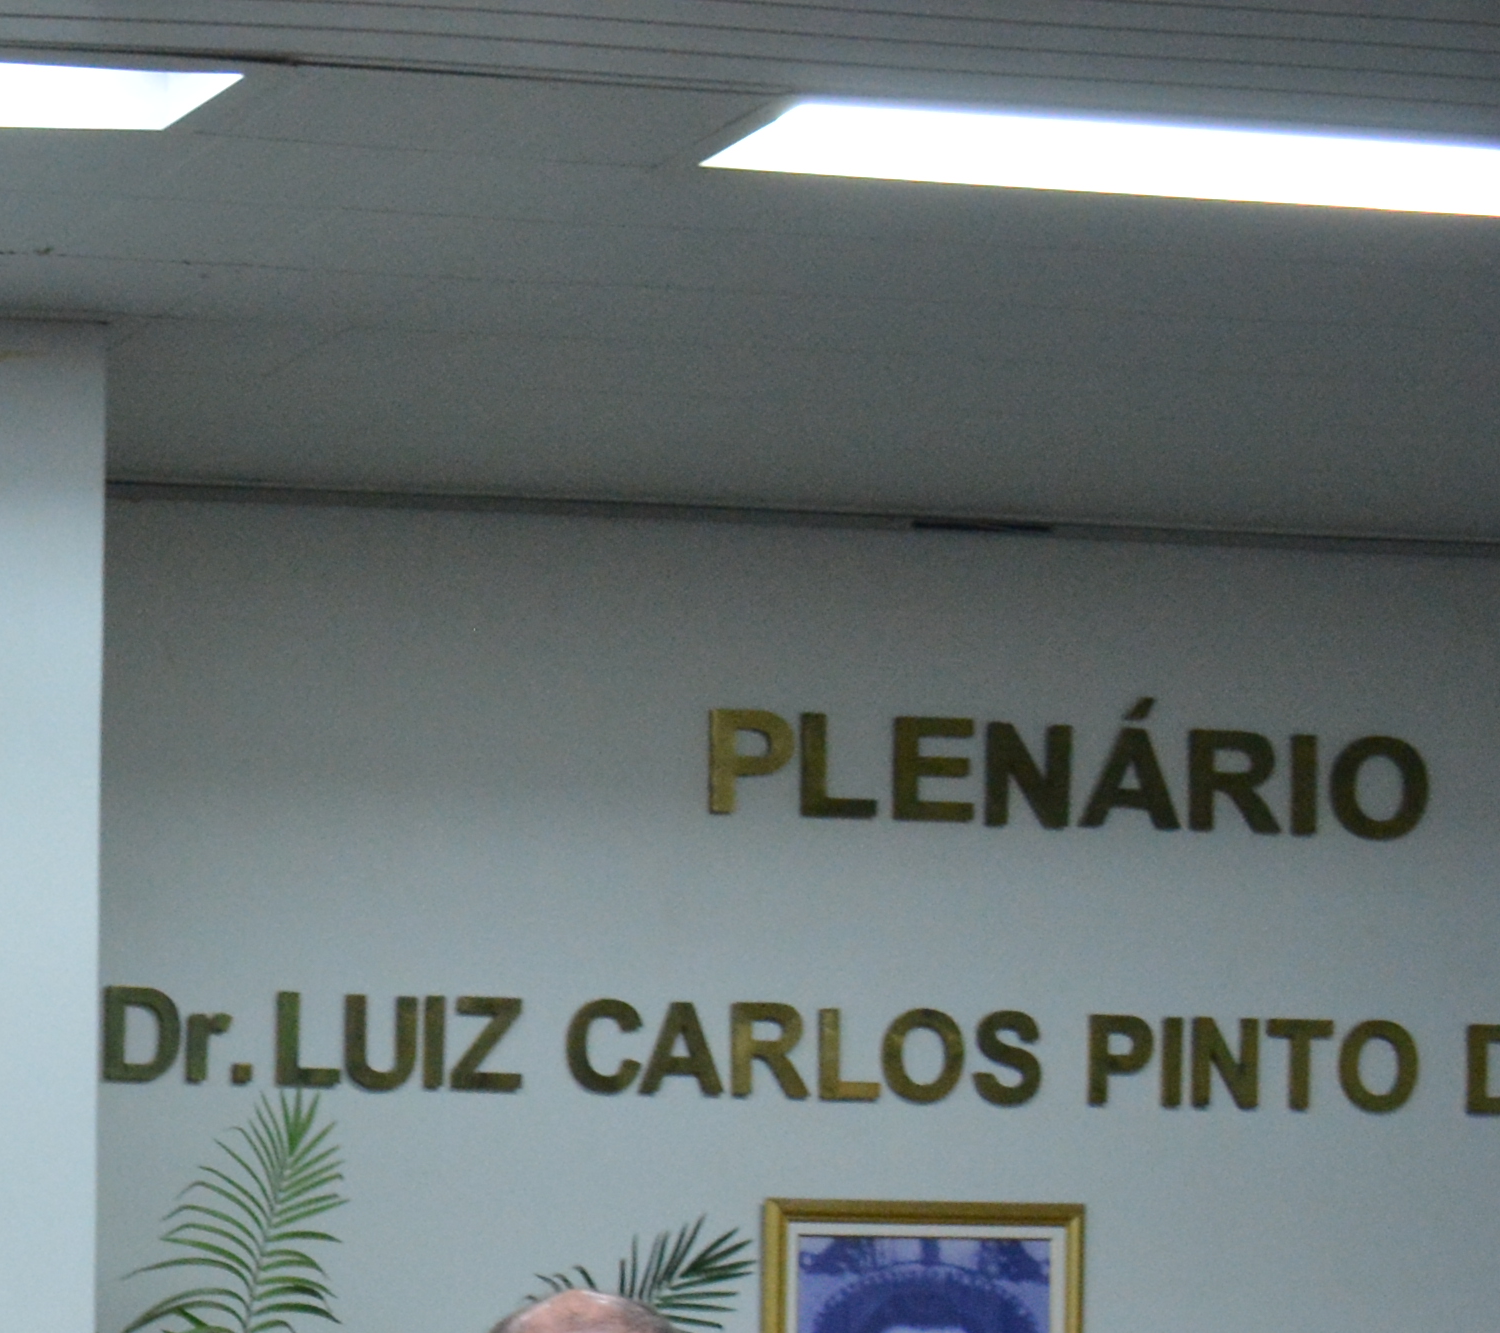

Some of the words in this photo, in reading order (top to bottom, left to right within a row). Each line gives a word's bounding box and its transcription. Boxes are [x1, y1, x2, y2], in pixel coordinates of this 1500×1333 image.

[707, 697, 1430, 842] PLENÁRIO
[566, 998, 1042, 1107] CARLOS
[1087, 1013, 1419, 1115] PINTO
